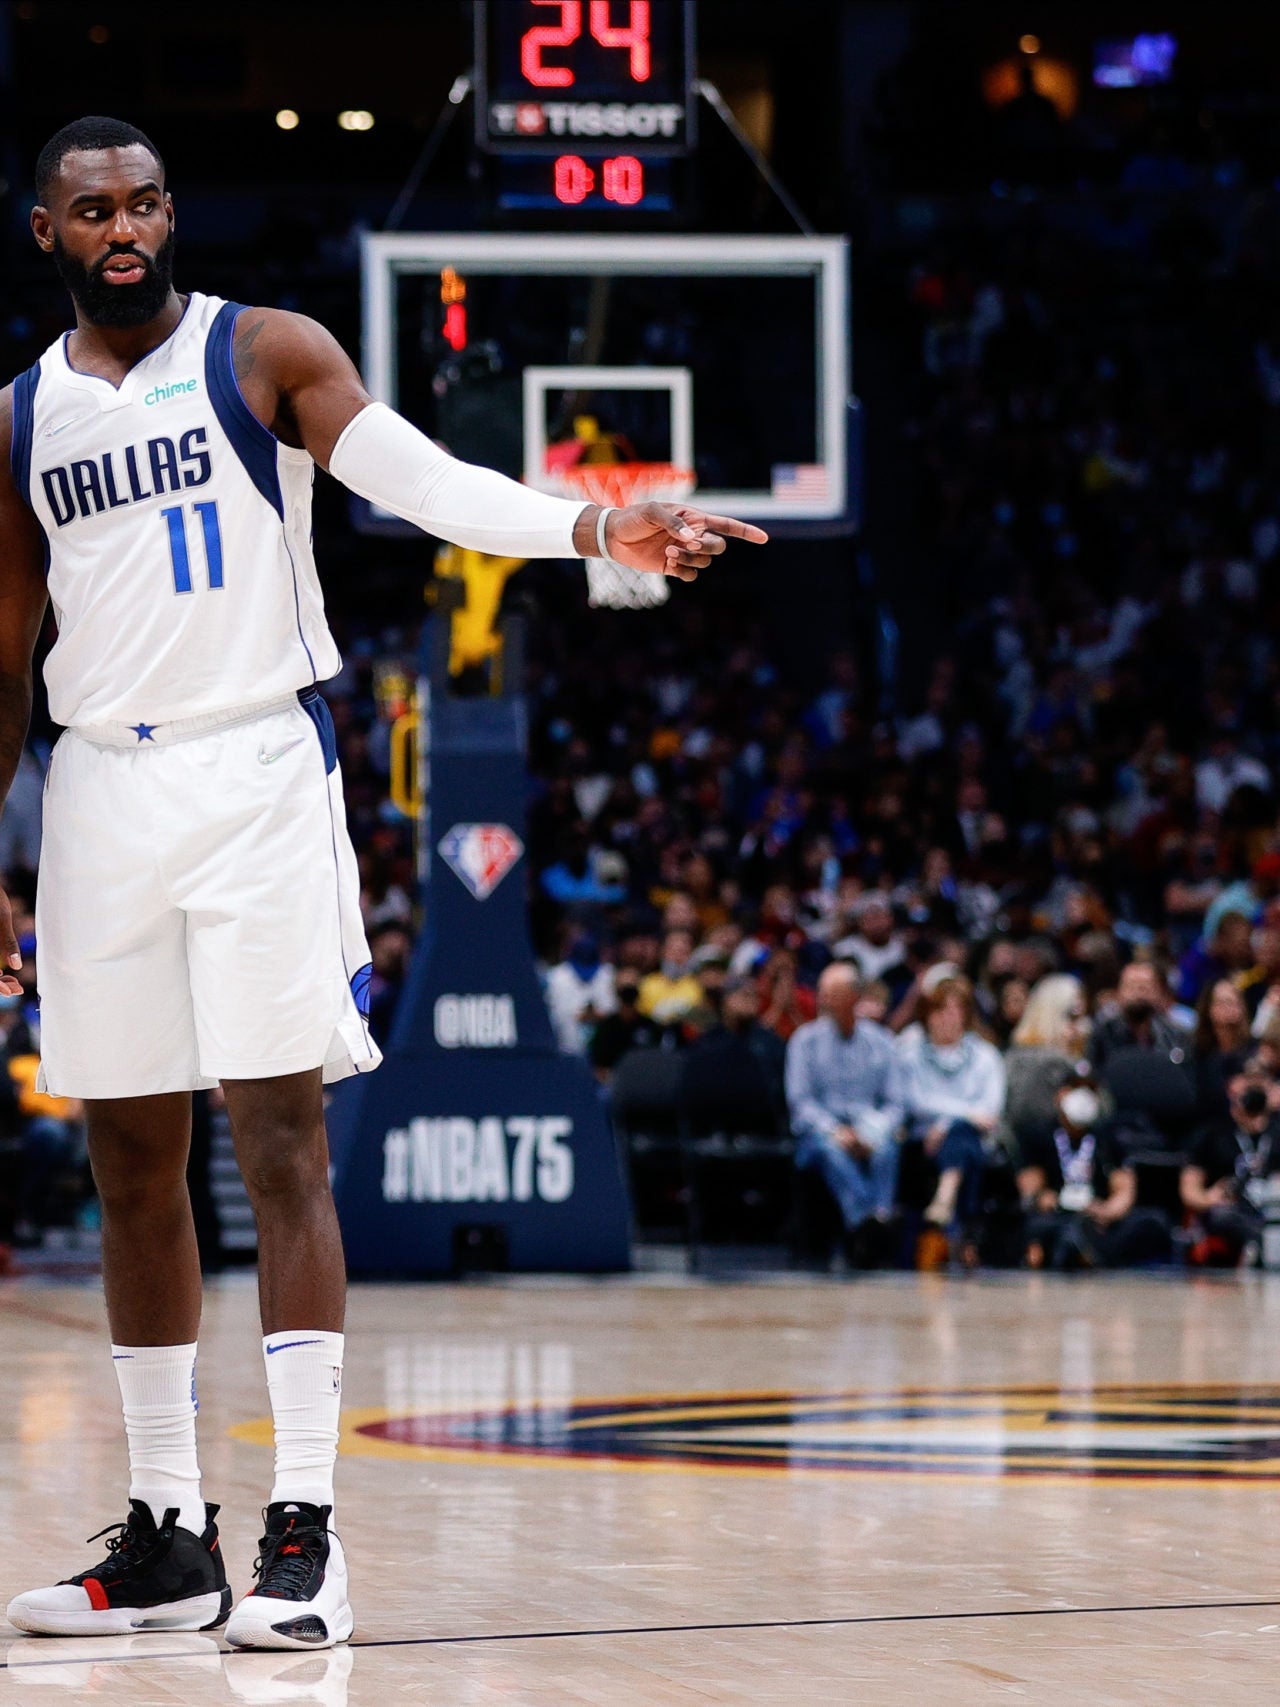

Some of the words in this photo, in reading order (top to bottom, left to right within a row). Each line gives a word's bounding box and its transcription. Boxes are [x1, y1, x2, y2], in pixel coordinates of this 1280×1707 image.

[521, 0, 650, 87] 24
[547, 103, 684, 137] TISSOT
[144, 378, 197, 406] chime
[40, 426, 212, 529] DALLAS
[160, 499, 225, 596] 11
[434, 994, 518, 1049] @NBA
[382, 1115, 575, 1202] #NBA75
